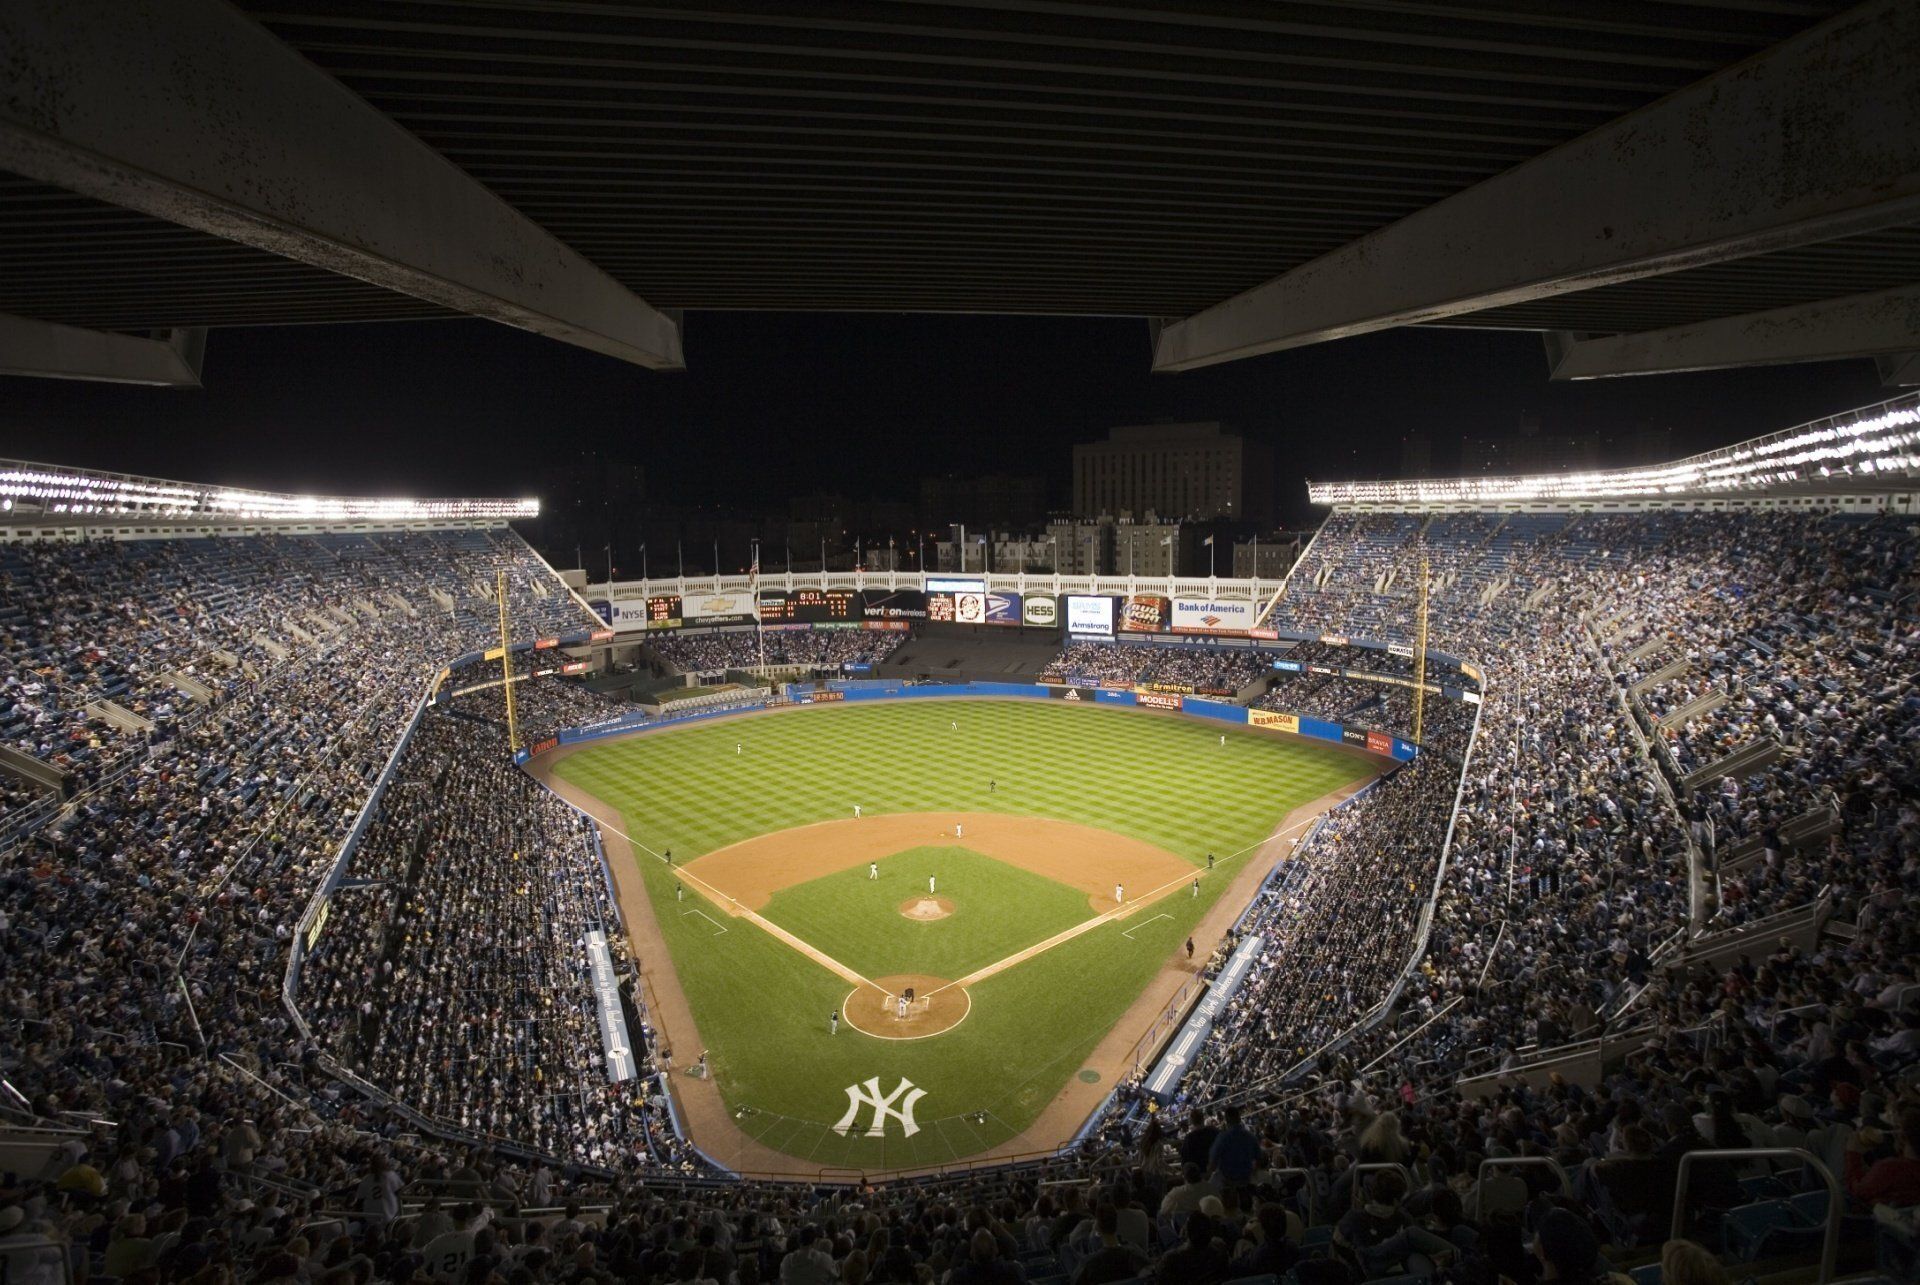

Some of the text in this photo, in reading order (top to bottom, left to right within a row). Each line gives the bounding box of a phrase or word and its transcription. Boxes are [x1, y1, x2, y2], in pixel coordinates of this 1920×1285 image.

[800, 592, 820, 600] 8:01
[1027, 605, 1053, 616] HESS
[1132, 604, 1159, 615] BUD
[1179, 602, 1244, 613] Bank of America
[622, 609, 644, 619] NYSE
[1072, 621, 1109, 631] Armstrong
[1153, 684, 1192, 692] Armitron
[1140, 695, 1178, 706] MODELL'S
[1344, 731, 1365, 740] SONY
[530, 738, 557, 756] Canon
[1368, 738, 1389, 747] BRAVIA
[1190, 976, 1234, 1033] New York Yankees
[444, 1251, 465, 1272] 21
